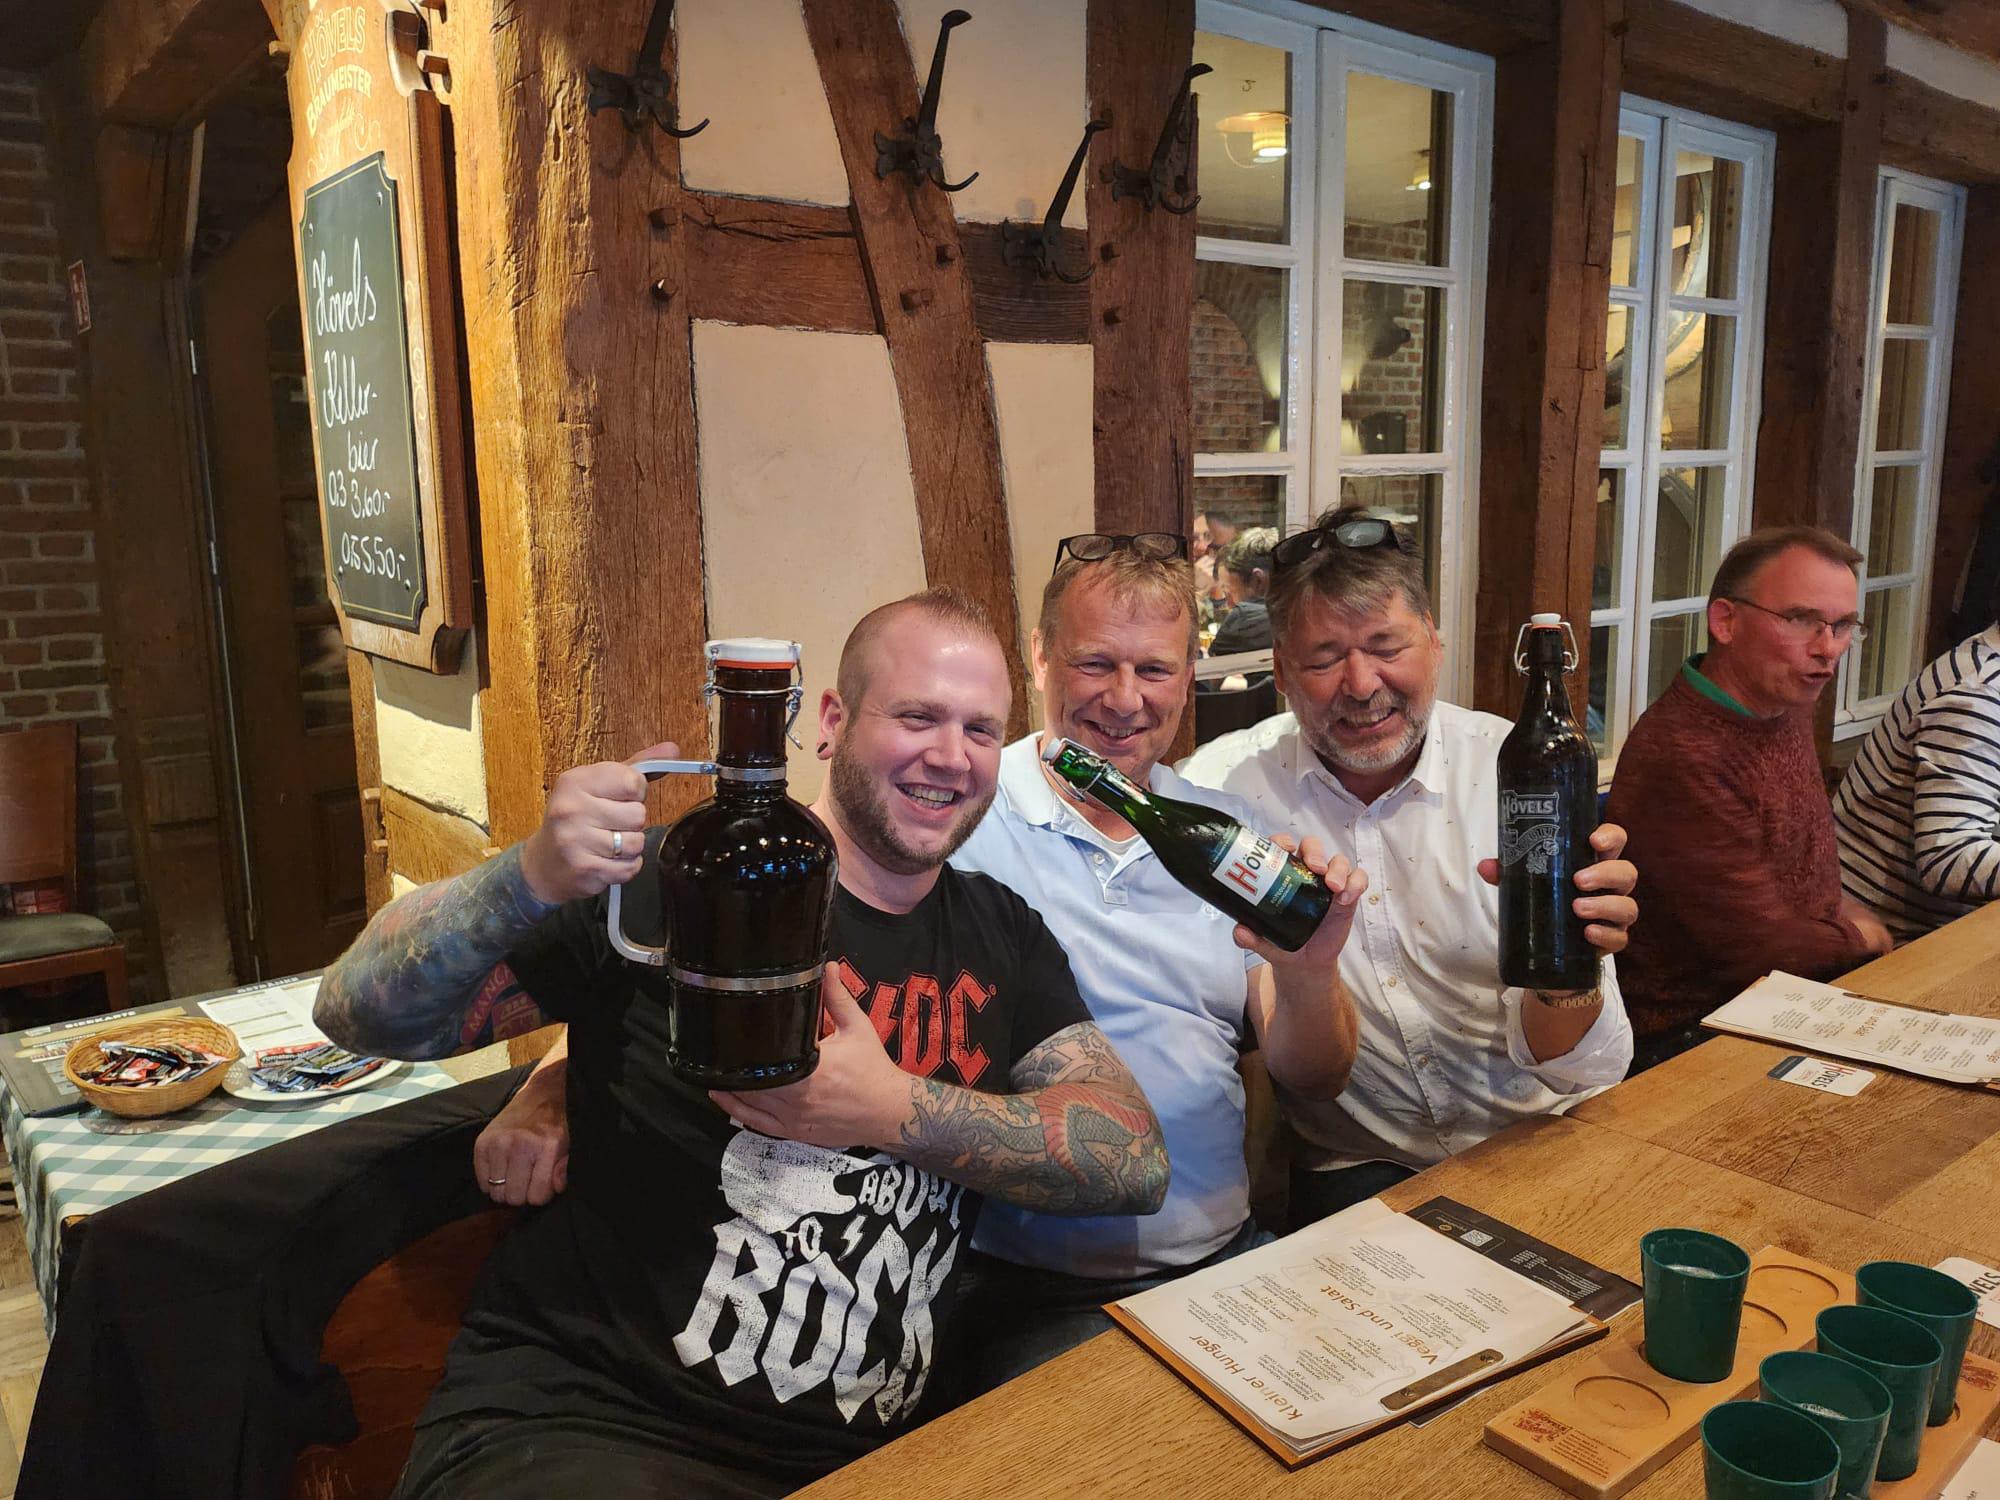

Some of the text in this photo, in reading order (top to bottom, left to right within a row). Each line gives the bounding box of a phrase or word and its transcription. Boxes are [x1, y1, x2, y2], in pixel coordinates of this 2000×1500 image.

[303, 6, 366, 97] HÖVELS
[305, 64, 373, 138] BRAUMEISTER
[312, 237, 377, 336] Hövels
[347, 431, 379, 473] bier
[1501, 795, 1555, 818] HÖVELS
[1224, 837, 1272, 897] HÖVEL
[1812, 1062, 1857, 1089] HÖVELS
[781, 1217, 825, 1261] TO
[1319, 1284, 1358, 1312] Salat
[672, 1217, 961, 1427] ROCK
[1358, 1311, 1393, 1331] und
[1188, 1334, 1246, 1375] Hunger
[1393, 1331, 1439, 1365] Veggi
